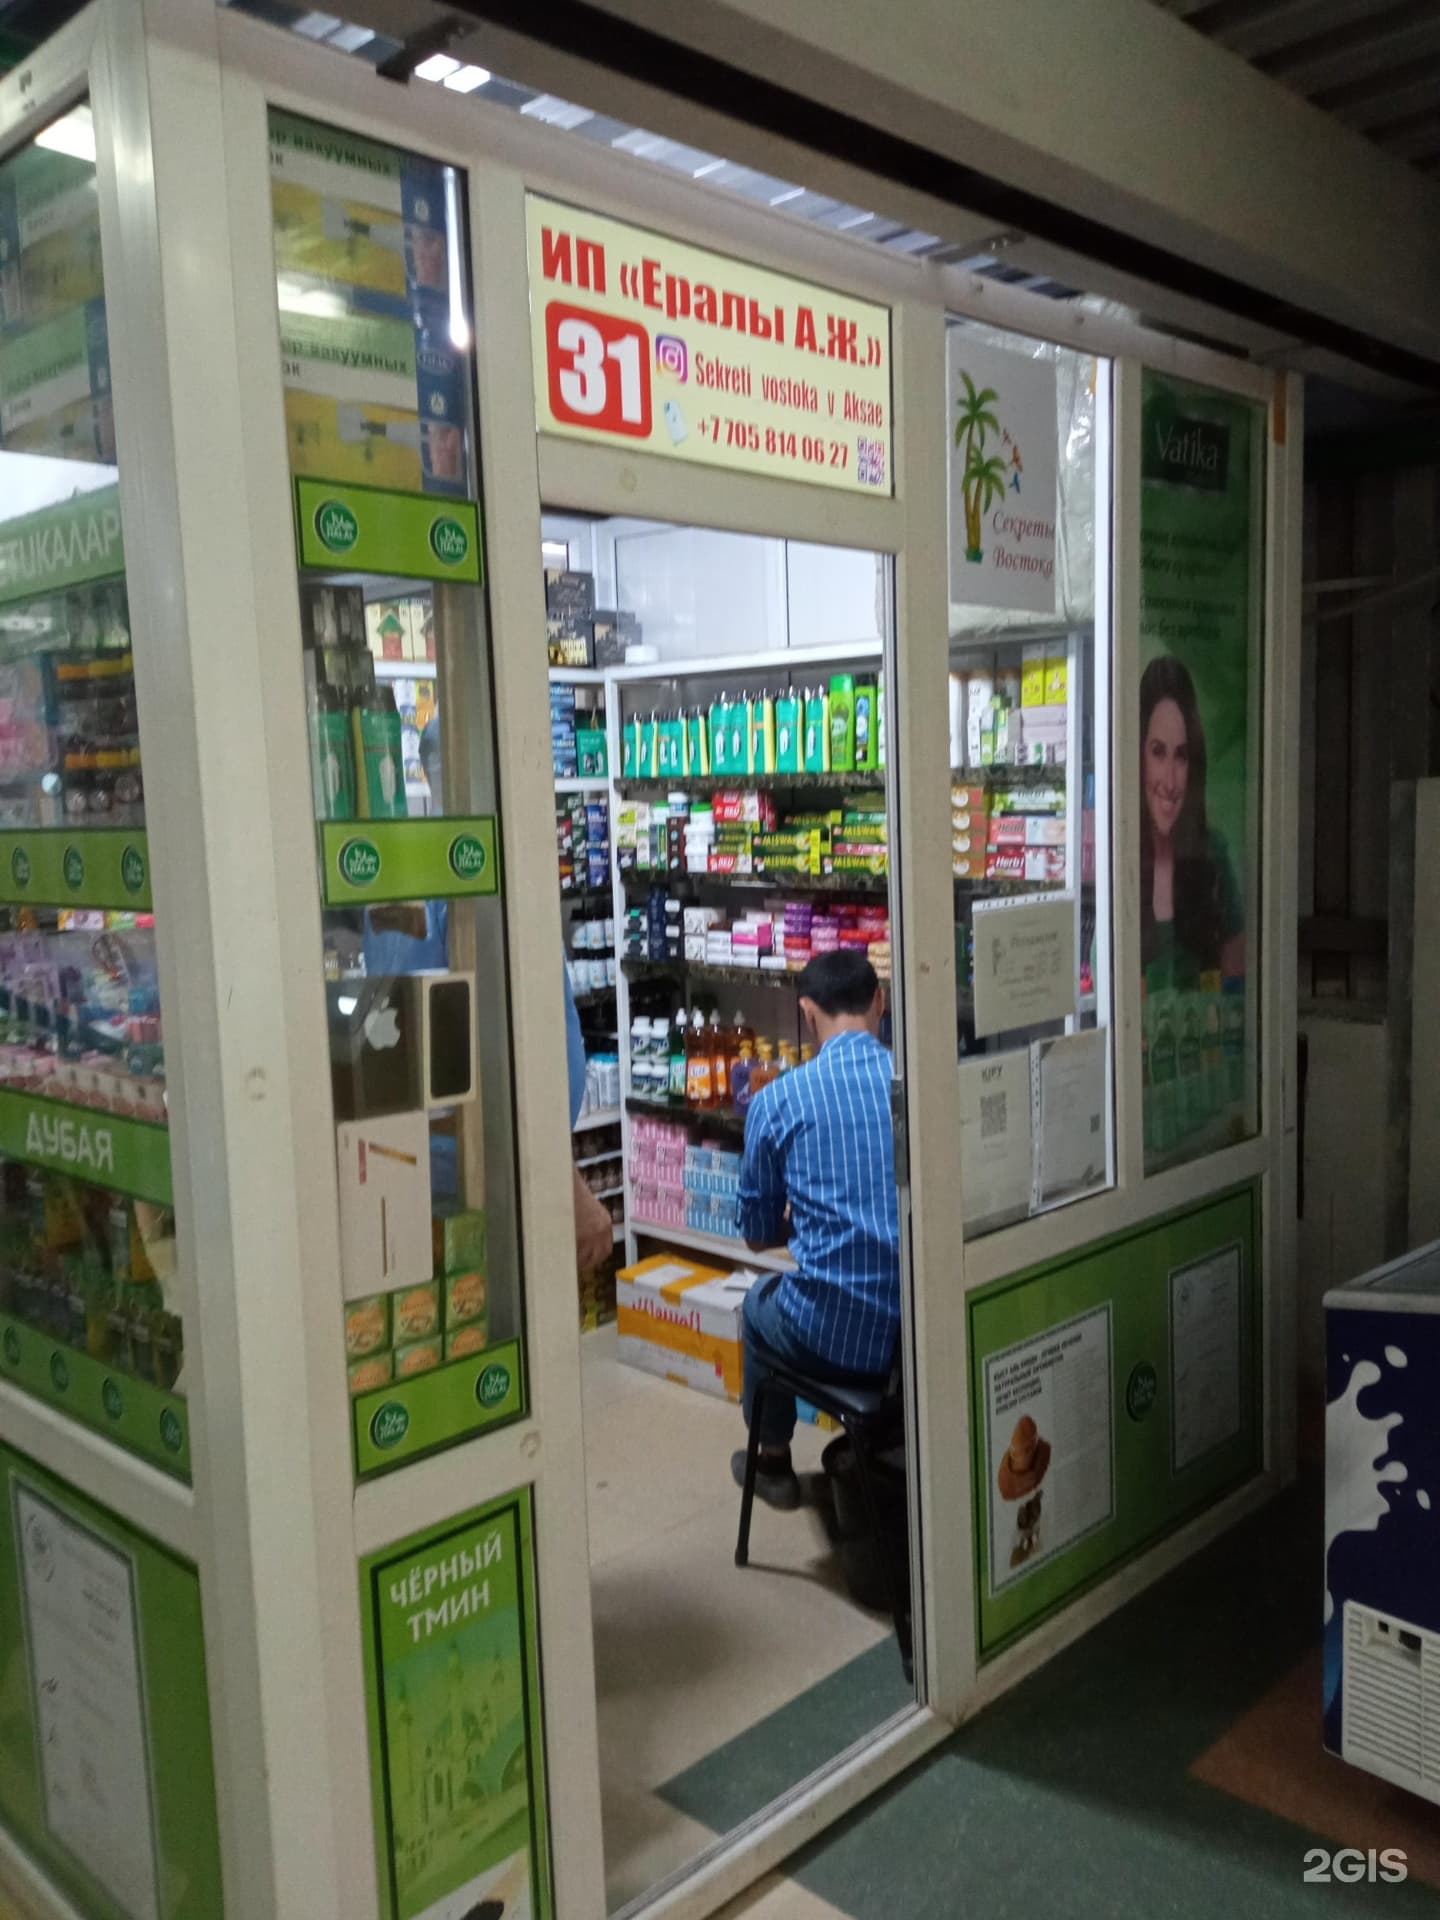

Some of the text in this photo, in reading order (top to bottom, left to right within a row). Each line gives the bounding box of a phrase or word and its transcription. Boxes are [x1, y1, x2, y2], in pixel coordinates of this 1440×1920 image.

[541, 226, 882, 368] ИП «Ералы А.Ж.»
[557, 317, 643, 426] 31
[695, 351, 752, 399] Sekreti
[762, 374, 819, 414] vostoka
[843, 390, 883, 428] Aksae
[698, 415, 849, 470] +7 705 814 06 27
[1155, 420, 1219, 473] Vatika
[992, 545, 1055, 578] Востока
[26, 1111, 114, 1175] ДУБАЯ
[390, 1528, 502, 1609] ЧЁРНЫЙ
[406, 1579, 490, 1644] ТМИН
